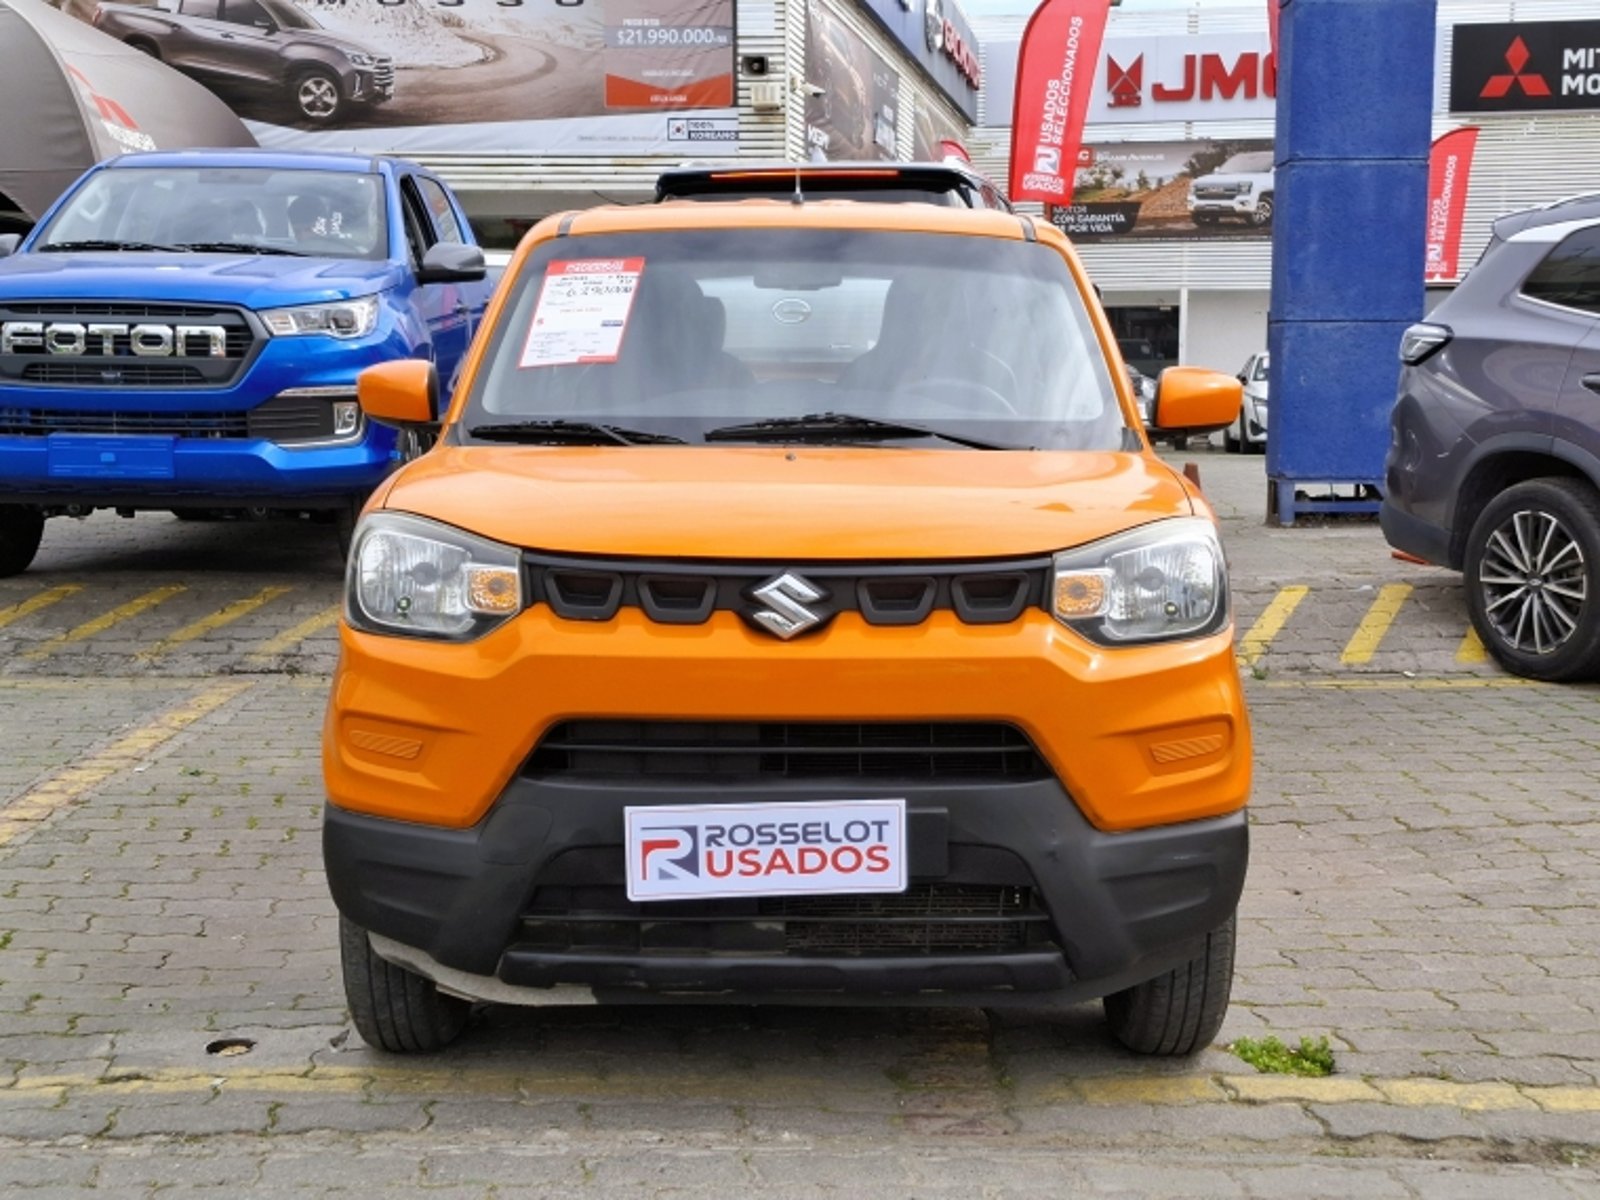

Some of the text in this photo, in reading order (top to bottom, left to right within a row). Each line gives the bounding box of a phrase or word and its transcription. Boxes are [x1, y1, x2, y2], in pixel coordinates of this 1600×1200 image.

[617, 28, 714, 44] $21.990.000
[1562, 48, 1600, 70] MI
[1053, 16, 1083, 146] SELECCIONADOS
[1040, 79, 1060, 143] USADOS
[1437, 155, 1458, 241] SELECCIONADOS
[1053, 214, 1075, 223] CON
[1068, 223, 1089, 232] POR
[1090, 223, 1114, 232] VIDA
[1, 321, 226, 357] FOTON
[705, 820, 889, 847] ROSSELOT
[706, 845, 891, 878] USADOS
